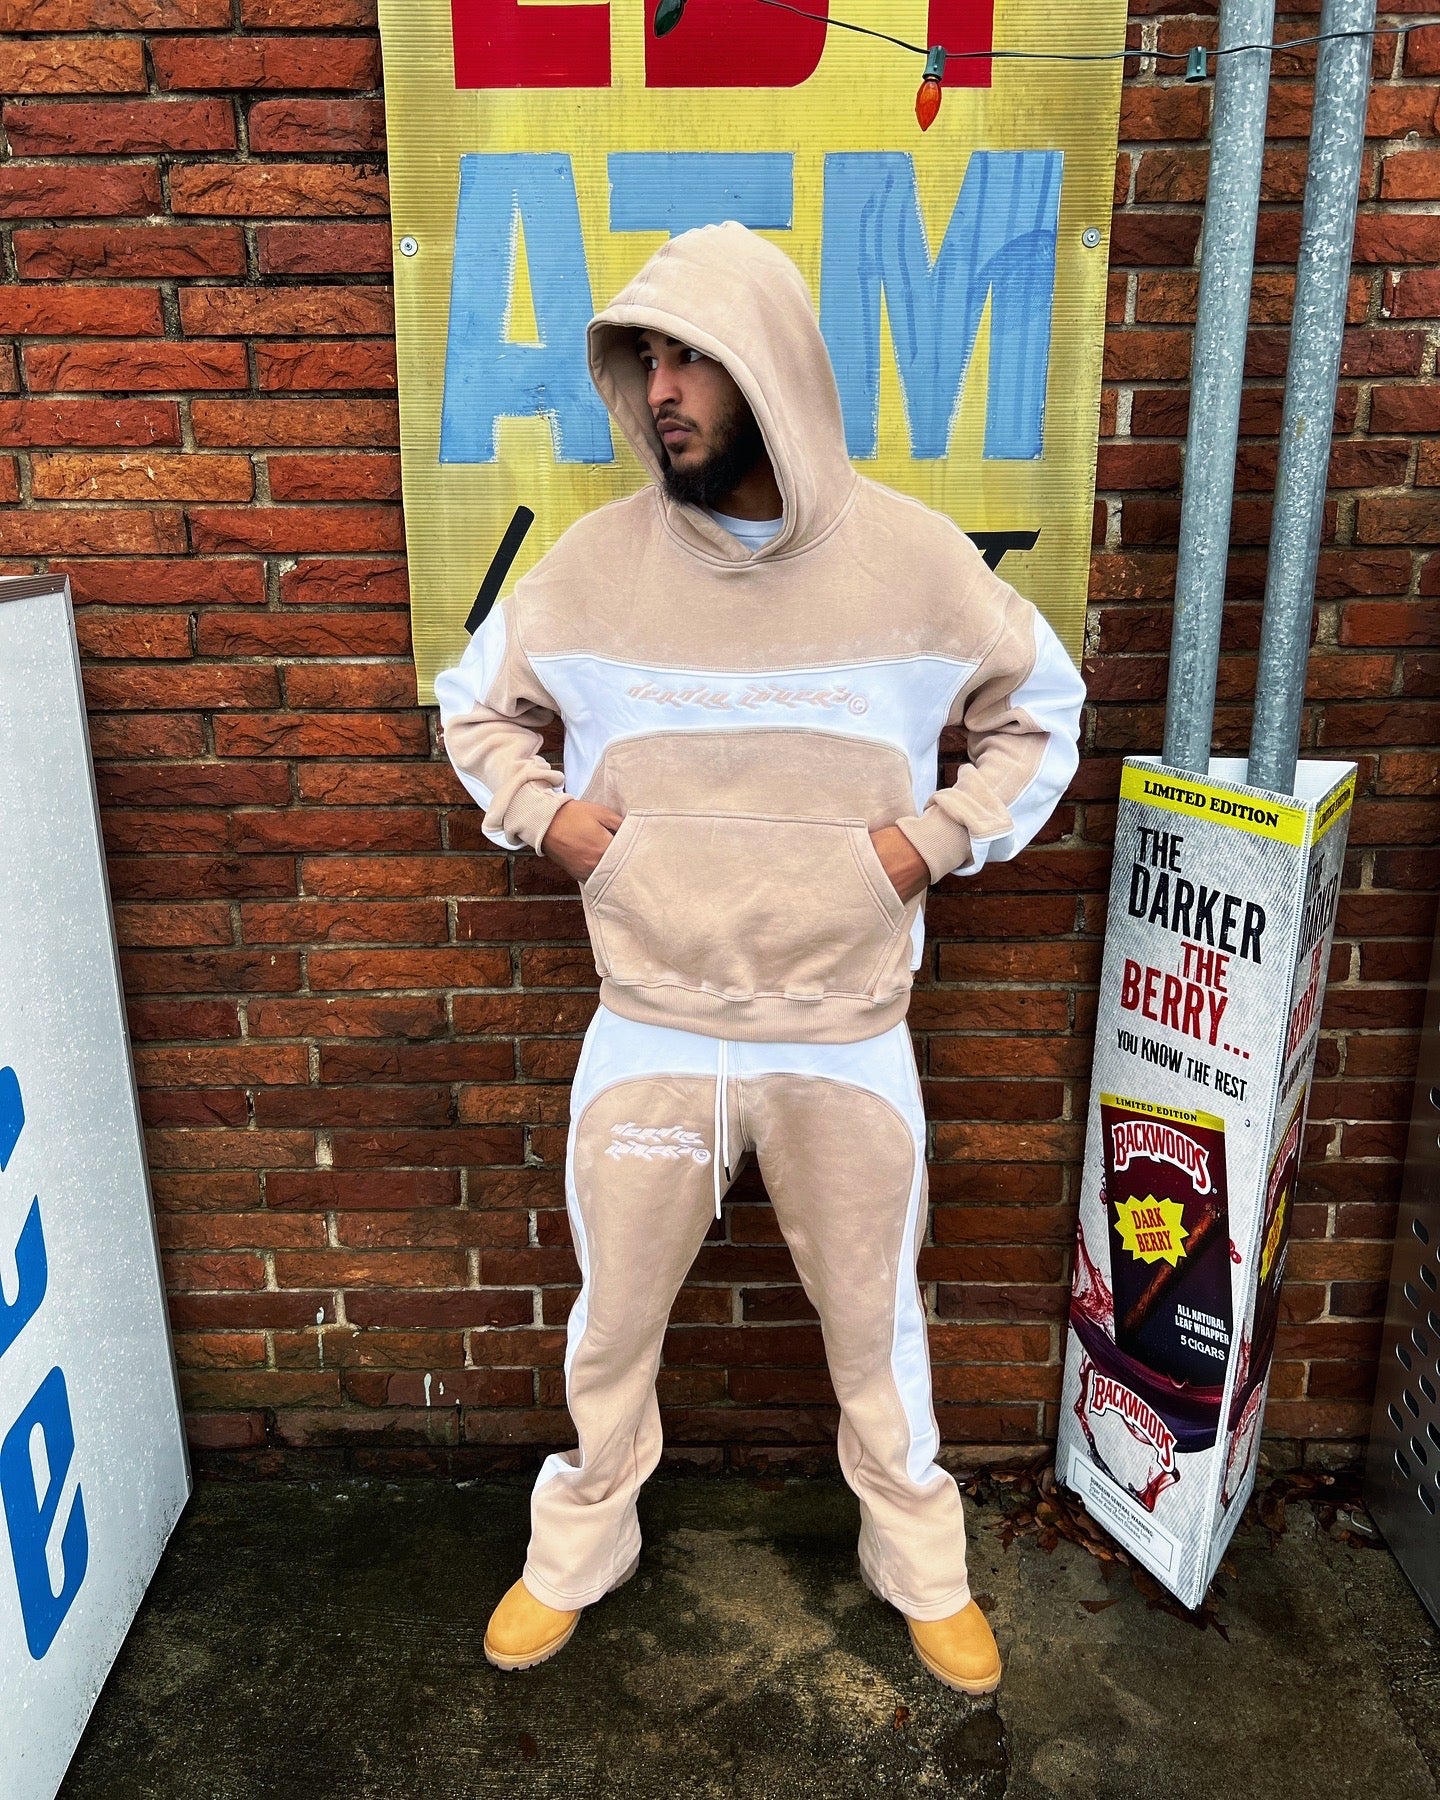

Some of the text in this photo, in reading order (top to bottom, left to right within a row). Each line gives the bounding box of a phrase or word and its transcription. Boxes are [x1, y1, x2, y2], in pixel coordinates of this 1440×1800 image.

[1143, 780, 1206, 808] LIMITED
[1209, 797, 1280, 828] EDITION
[1137, 826, 1184, 873] THE
[1128, 862, 1266, 964] DARKER
[1180, 941, 1230, 993] THE
[1120, 958, 1250, 1059] BERRY...
[1117, 1028, 1248, 1101] YOU KNOW THE REST
[1116, 1097, 1198, 1122] LIMITED EDITION
[1113, 1122, 1209, 1192] BACKWOODS
[1131, 1207, 1166, 1230] DARK
[1135, 1230, 1173, 1253] BERRY
[1174, 1314, 1230, 1345] LEAF WRAPPER
[1177, 1304, 1226, 1332] ALL NATURAL
[1180, 1334, 1225, 1361] 5 CIGARS
[1091, 1376, 1175, 1469] BACKWOODS
